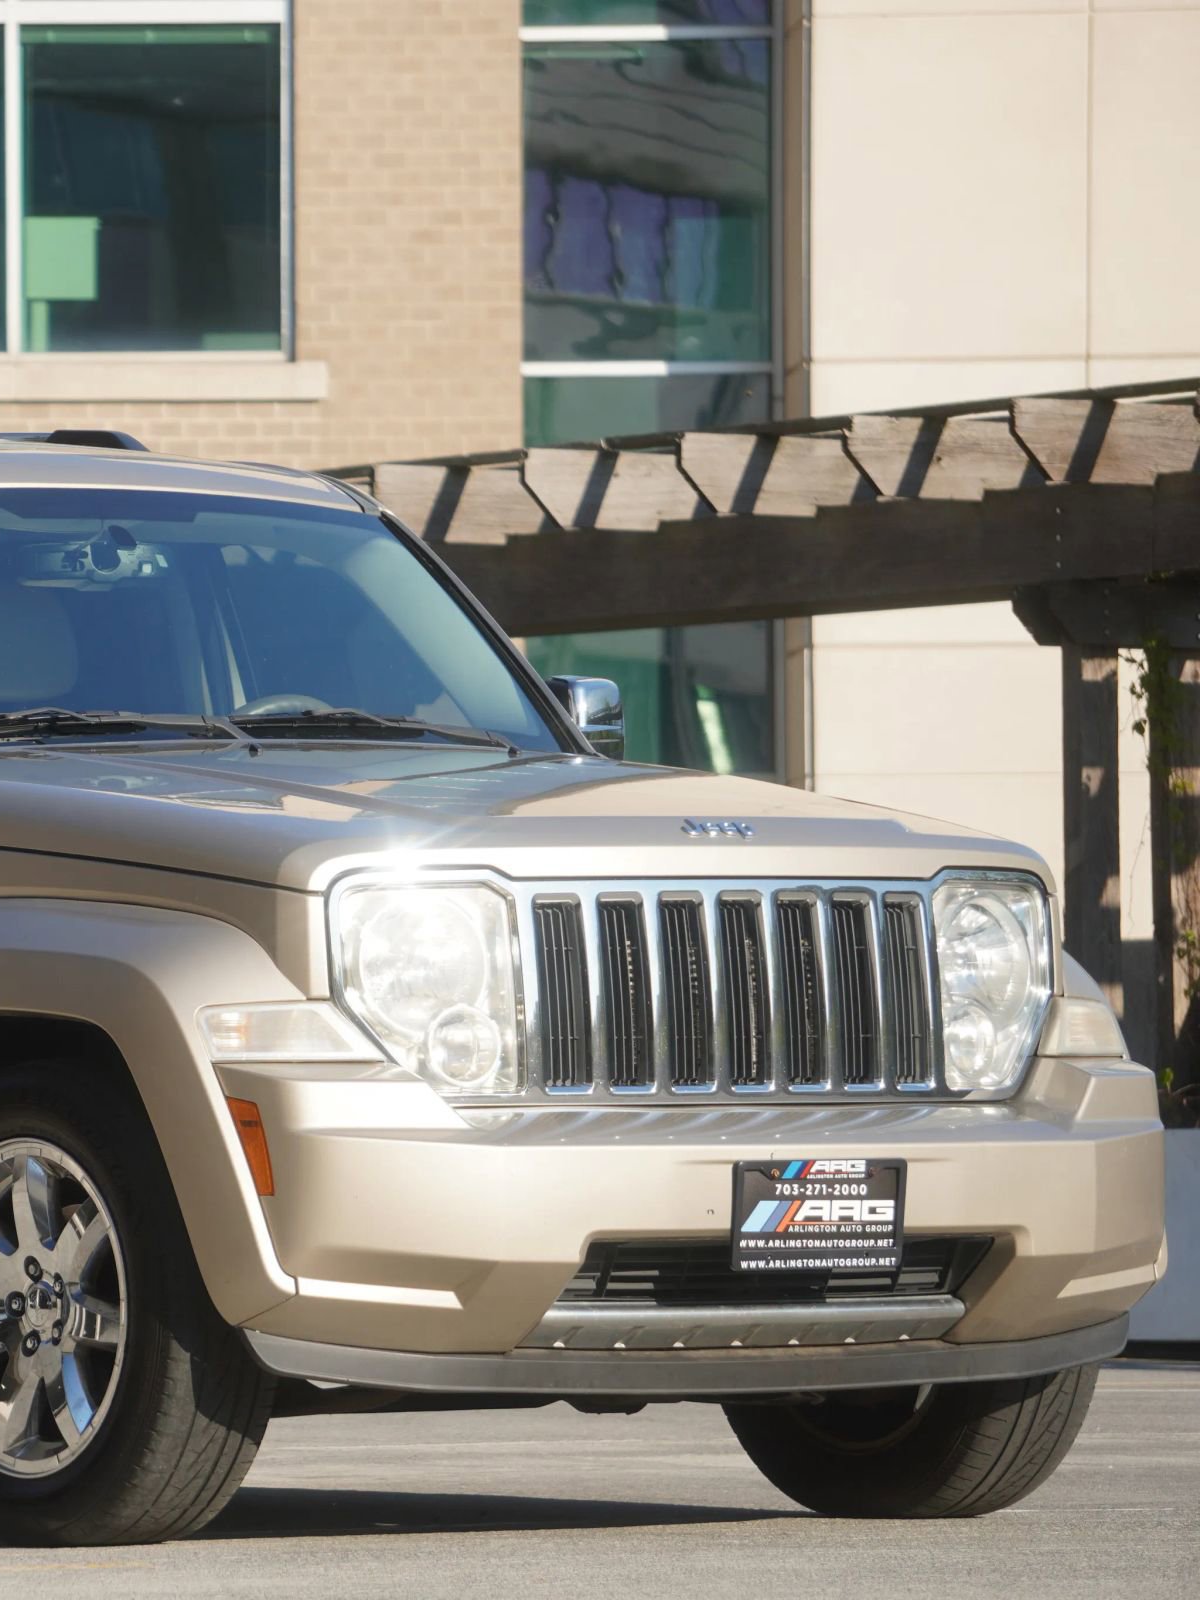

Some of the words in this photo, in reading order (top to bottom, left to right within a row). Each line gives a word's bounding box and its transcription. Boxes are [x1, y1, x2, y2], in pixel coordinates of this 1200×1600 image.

[680, 818, 755, 841] Jeep
[810, 1160, 866, 1172] AAG
[775, 1183, 867, 1196] 703-271-2000
[793, 1200, 895, 1221] AAG
[788, 1224, 837, 1233] ARLINGTON
[840, 1224, 862, 1232] AUTO
[865, 1224, 893, 1232] GROUP
[740, 1239, 894, 1248] WWW.ARLINGTONAUTOGROUP.NET
[741, 1258, 896, 1268] WWW.ARLINGTONAUTOGROUP.NET
